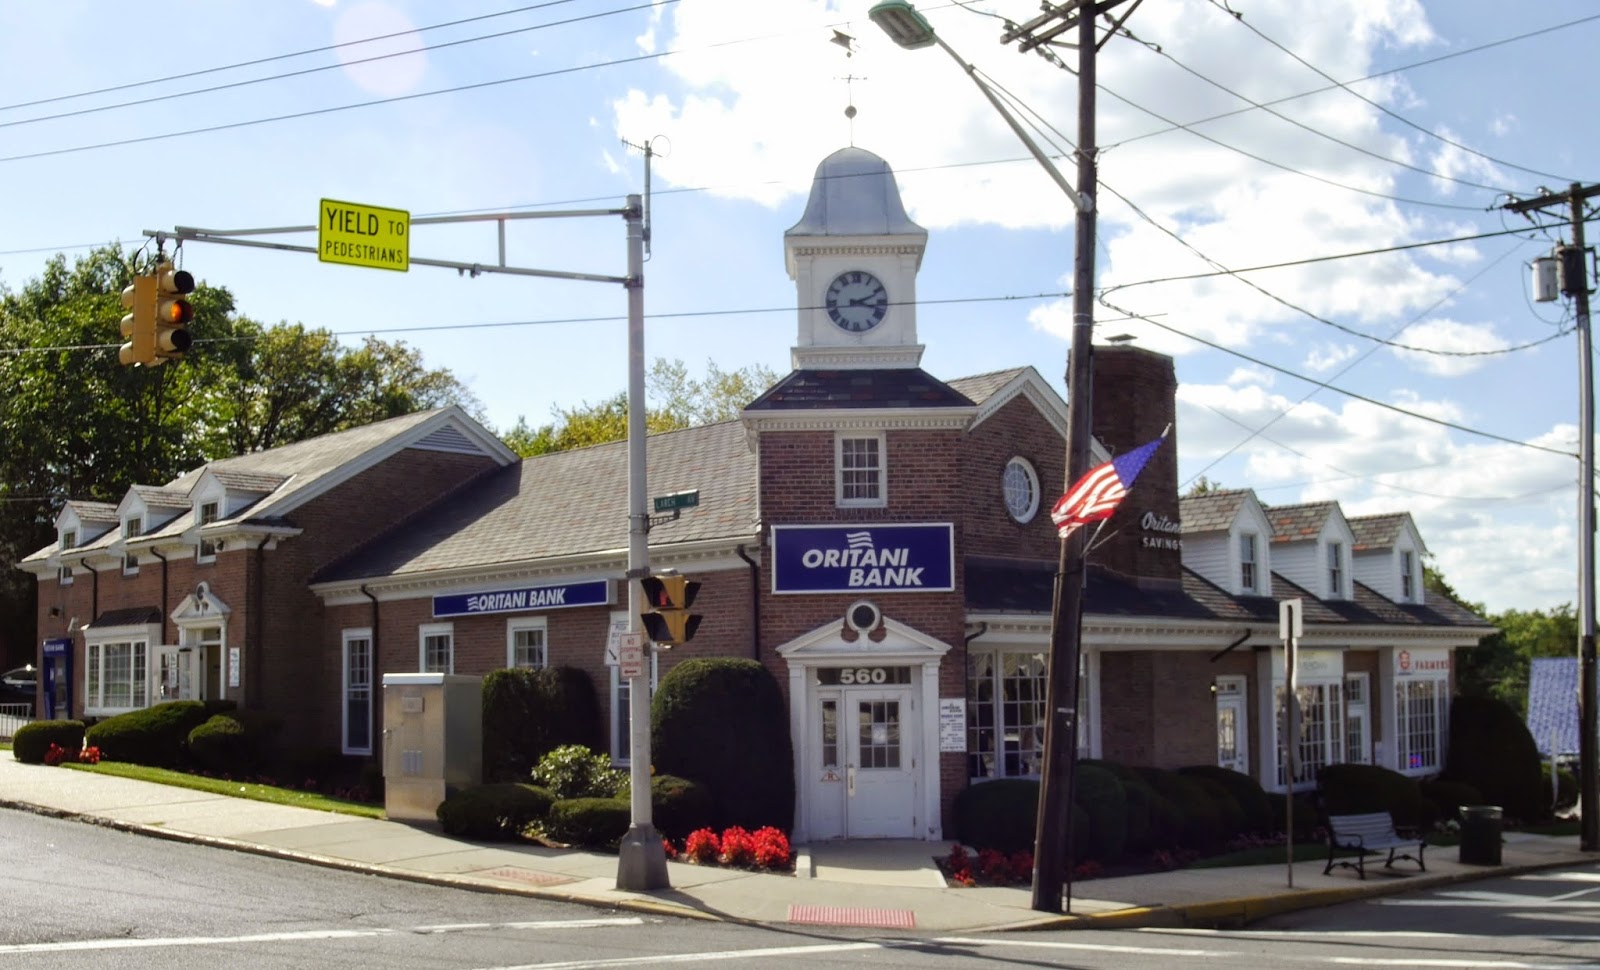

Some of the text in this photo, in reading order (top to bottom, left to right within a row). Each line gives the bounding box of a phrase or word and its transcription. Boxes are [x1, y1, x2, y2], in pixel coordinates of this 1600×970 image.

[326, 207, 405, 237] YIELD TO
[325, 240, 404, 264] PEDESTRIANS
[1142, 536, 1184, 551] SAVINGS
[802, 548, 909, 568] ORITANI
[848, 567, 925, 587] BANK
[479, 587, 566, 611] ORITANI BANK
[840, 668, 887, 685] 560
